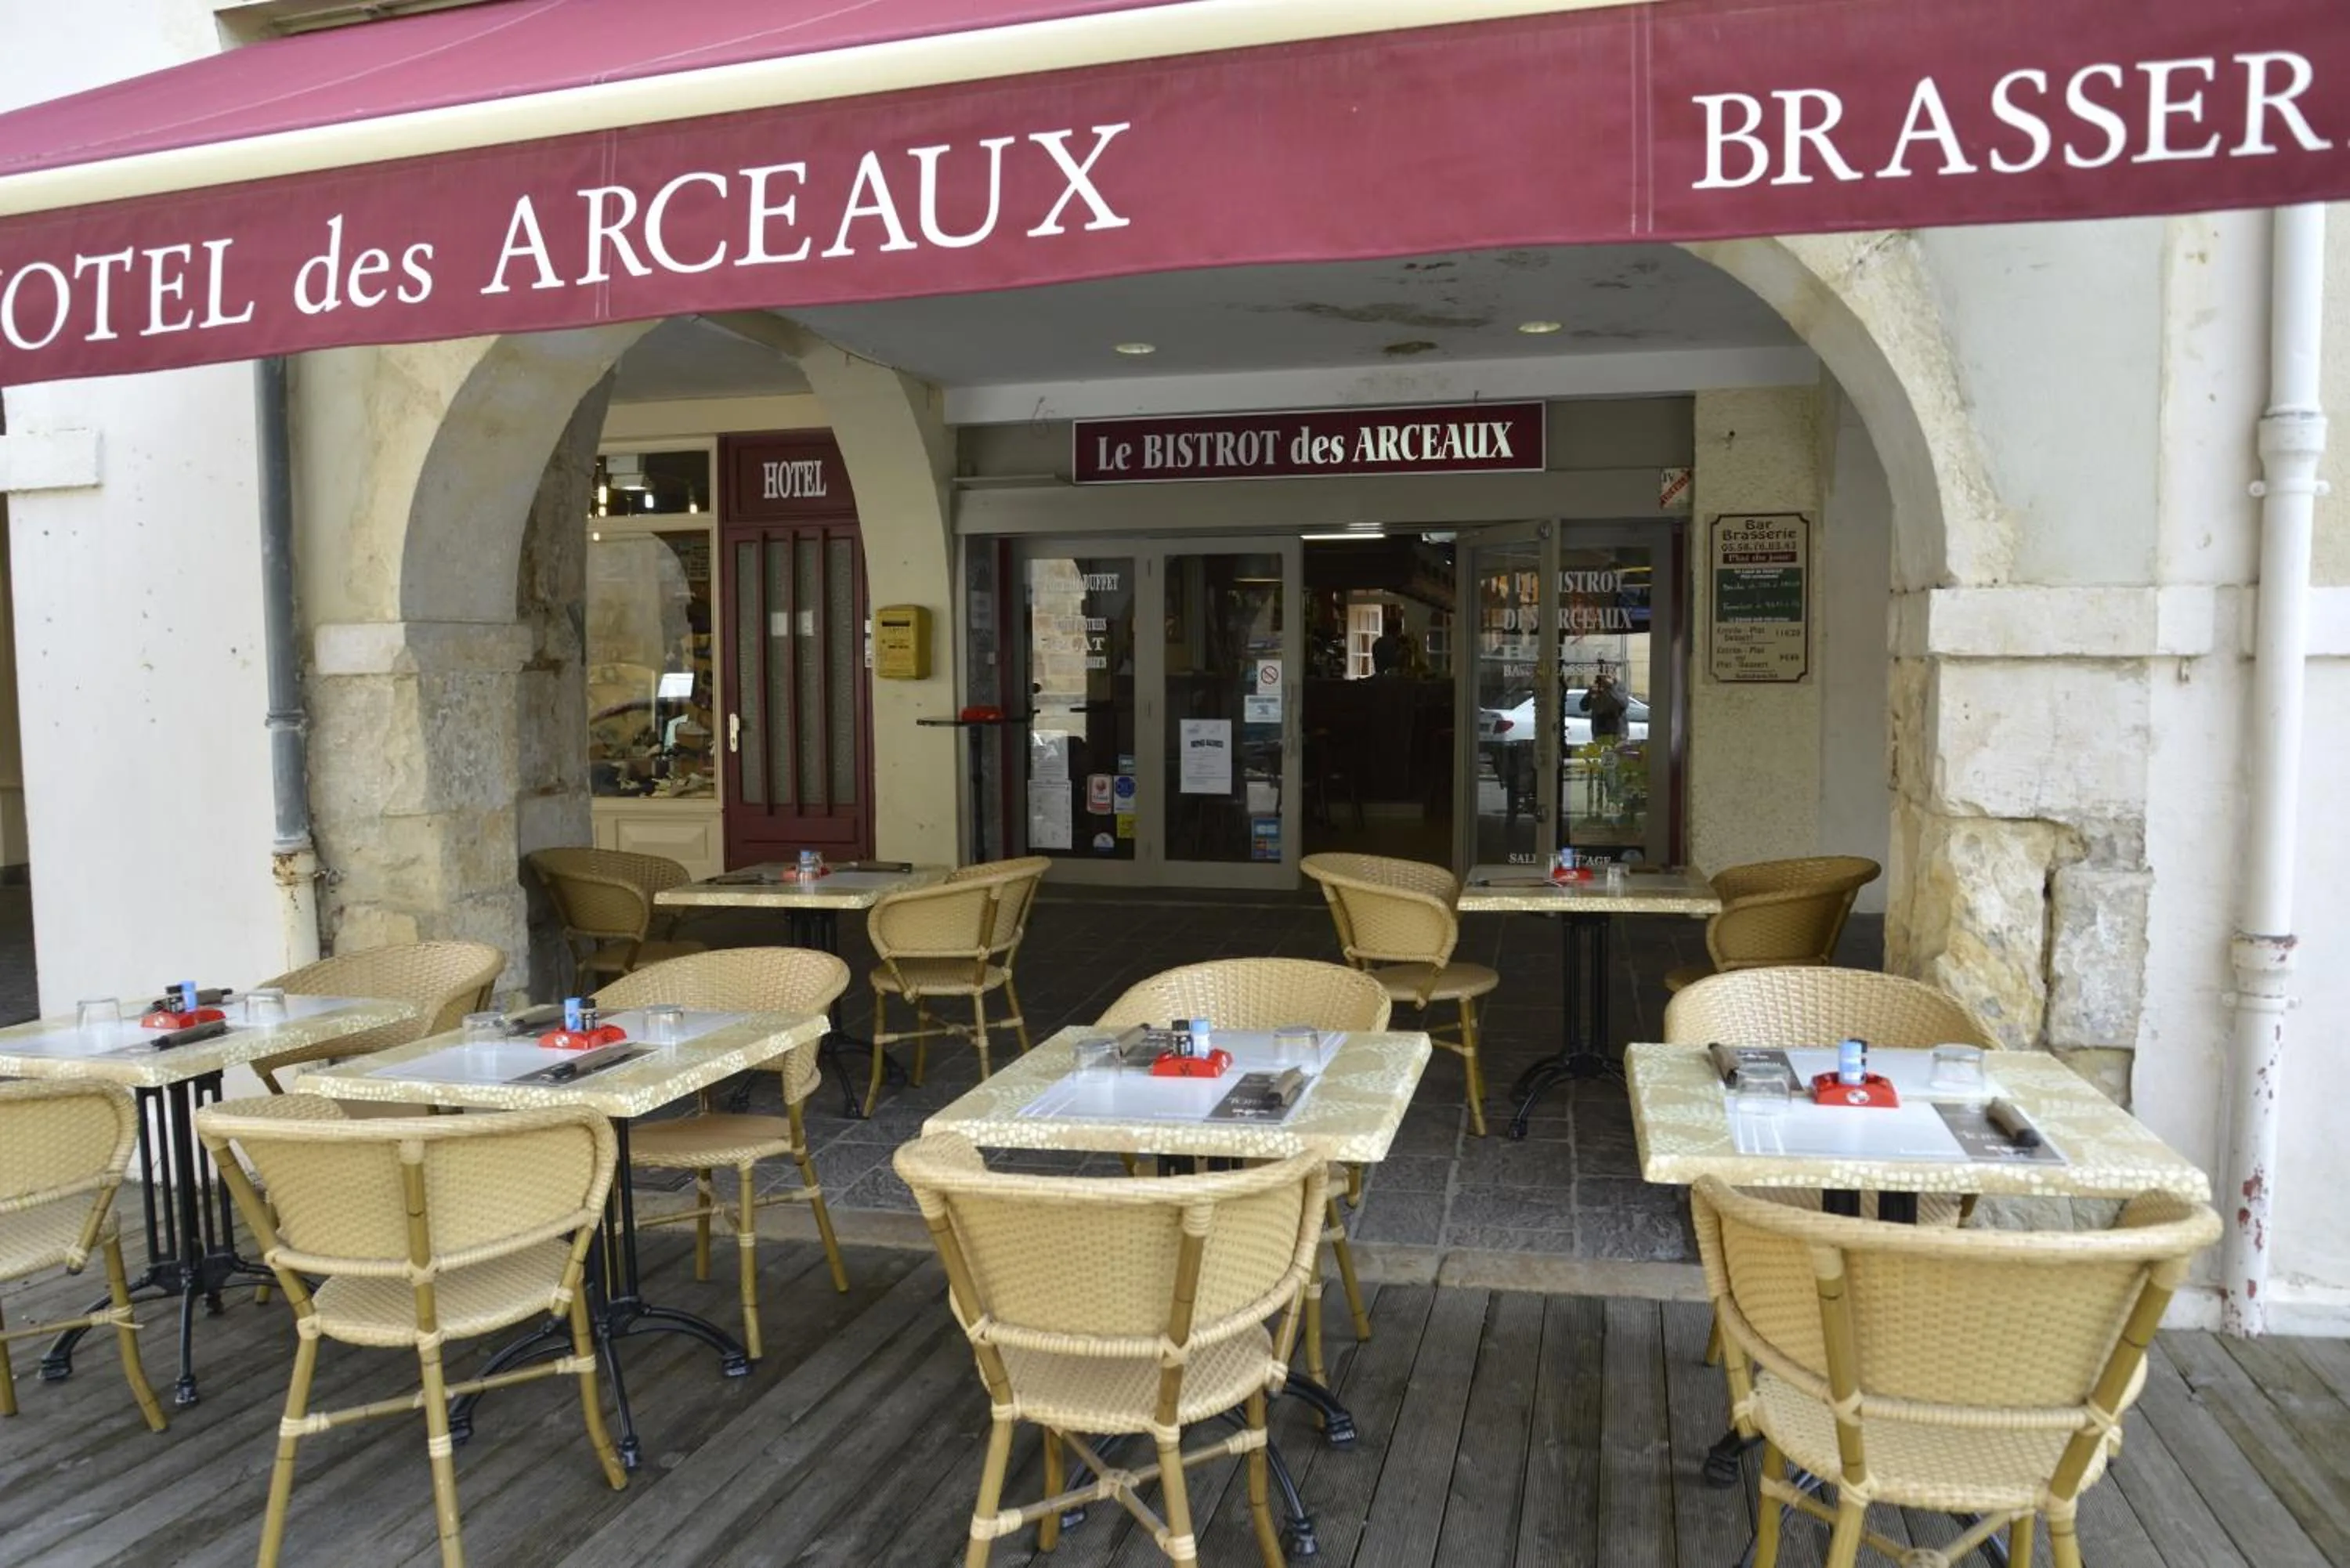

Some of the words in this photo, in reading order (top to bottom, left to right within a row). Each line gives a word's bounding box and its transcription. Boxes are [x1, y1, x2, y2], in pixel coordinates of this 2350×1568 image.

[1691, 51, 2350, 190] BRASSER
[0, 238, 255, 351] OTEL
[293, 213, 435, 314] des
[480, 122, 1131, 294] ARCEAUX
[1097, 435, 1133, 471] Le
[1143, 429, 1281, 468] BISTROT
[1290, 425, 1345, 464] des
[1352, 421, 1515, 463] ARCEAUX
[762, 460, 827, 500] HOTEL
[1722, 528, 1797, 541] Brasserie
[1745, 519, 1773, 530] Bar
[1557, 571, 1623, 594] ISTROT
[1557, 607, 1633, 630] RCEAUX
